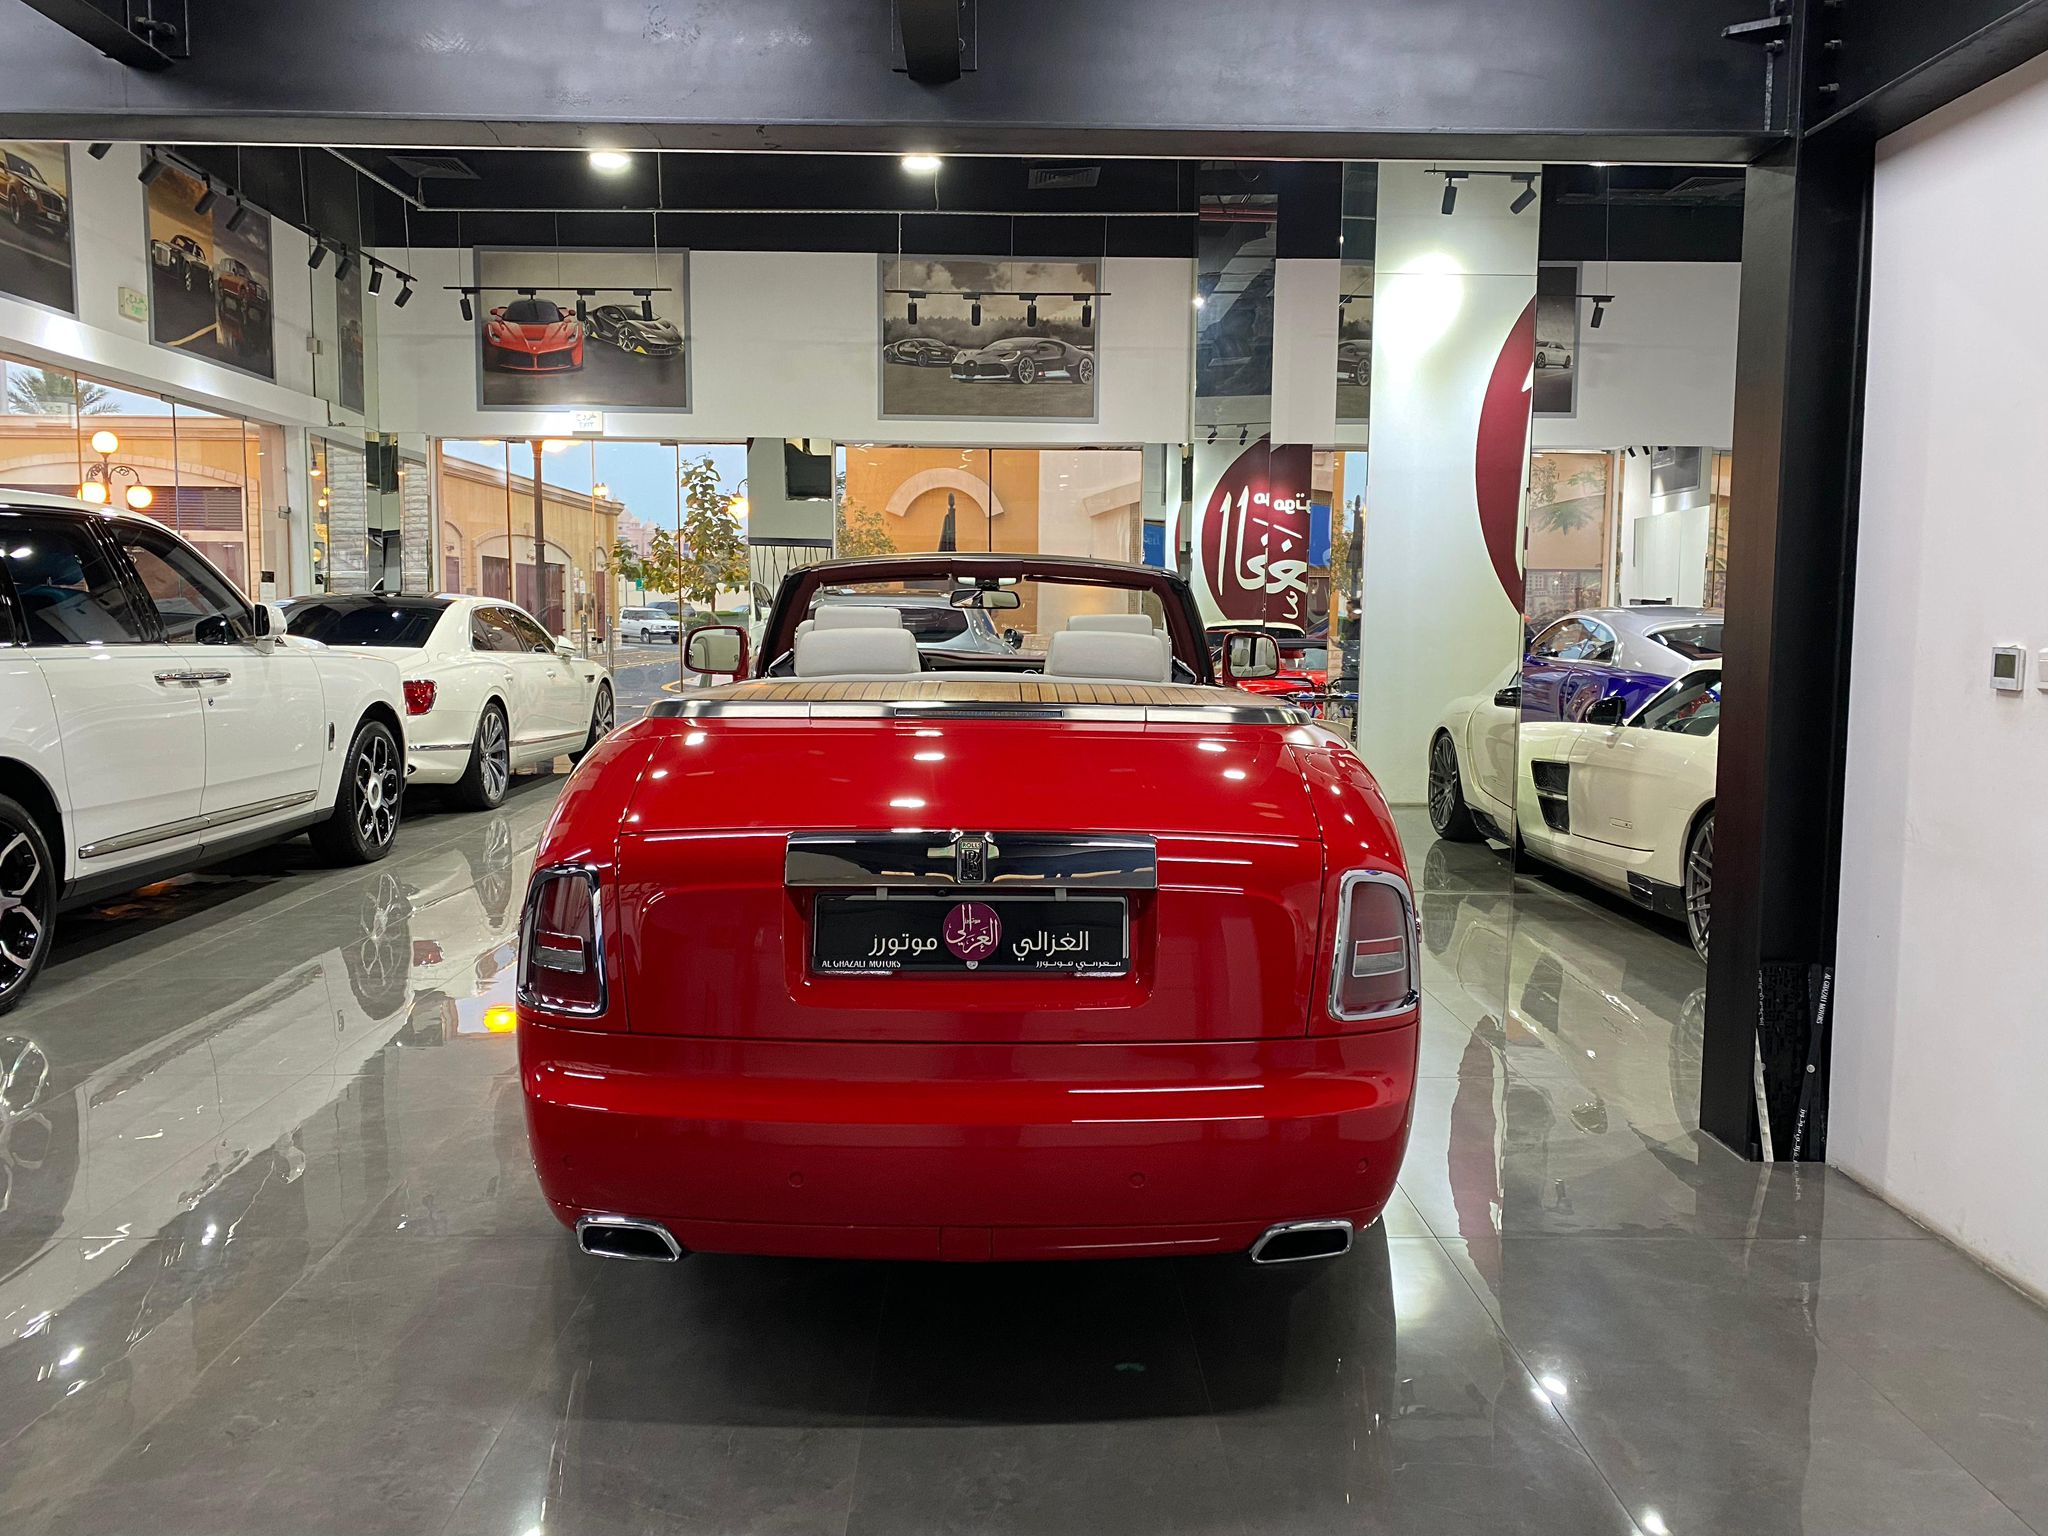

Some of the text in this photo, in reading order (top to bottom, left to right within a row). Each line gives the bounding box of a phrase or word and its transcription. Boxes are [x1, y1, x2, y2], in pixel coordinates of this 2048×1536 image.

[868, 930, 1089, 961] الغزالي موتورز
[821, 960, 832, 968] AL
